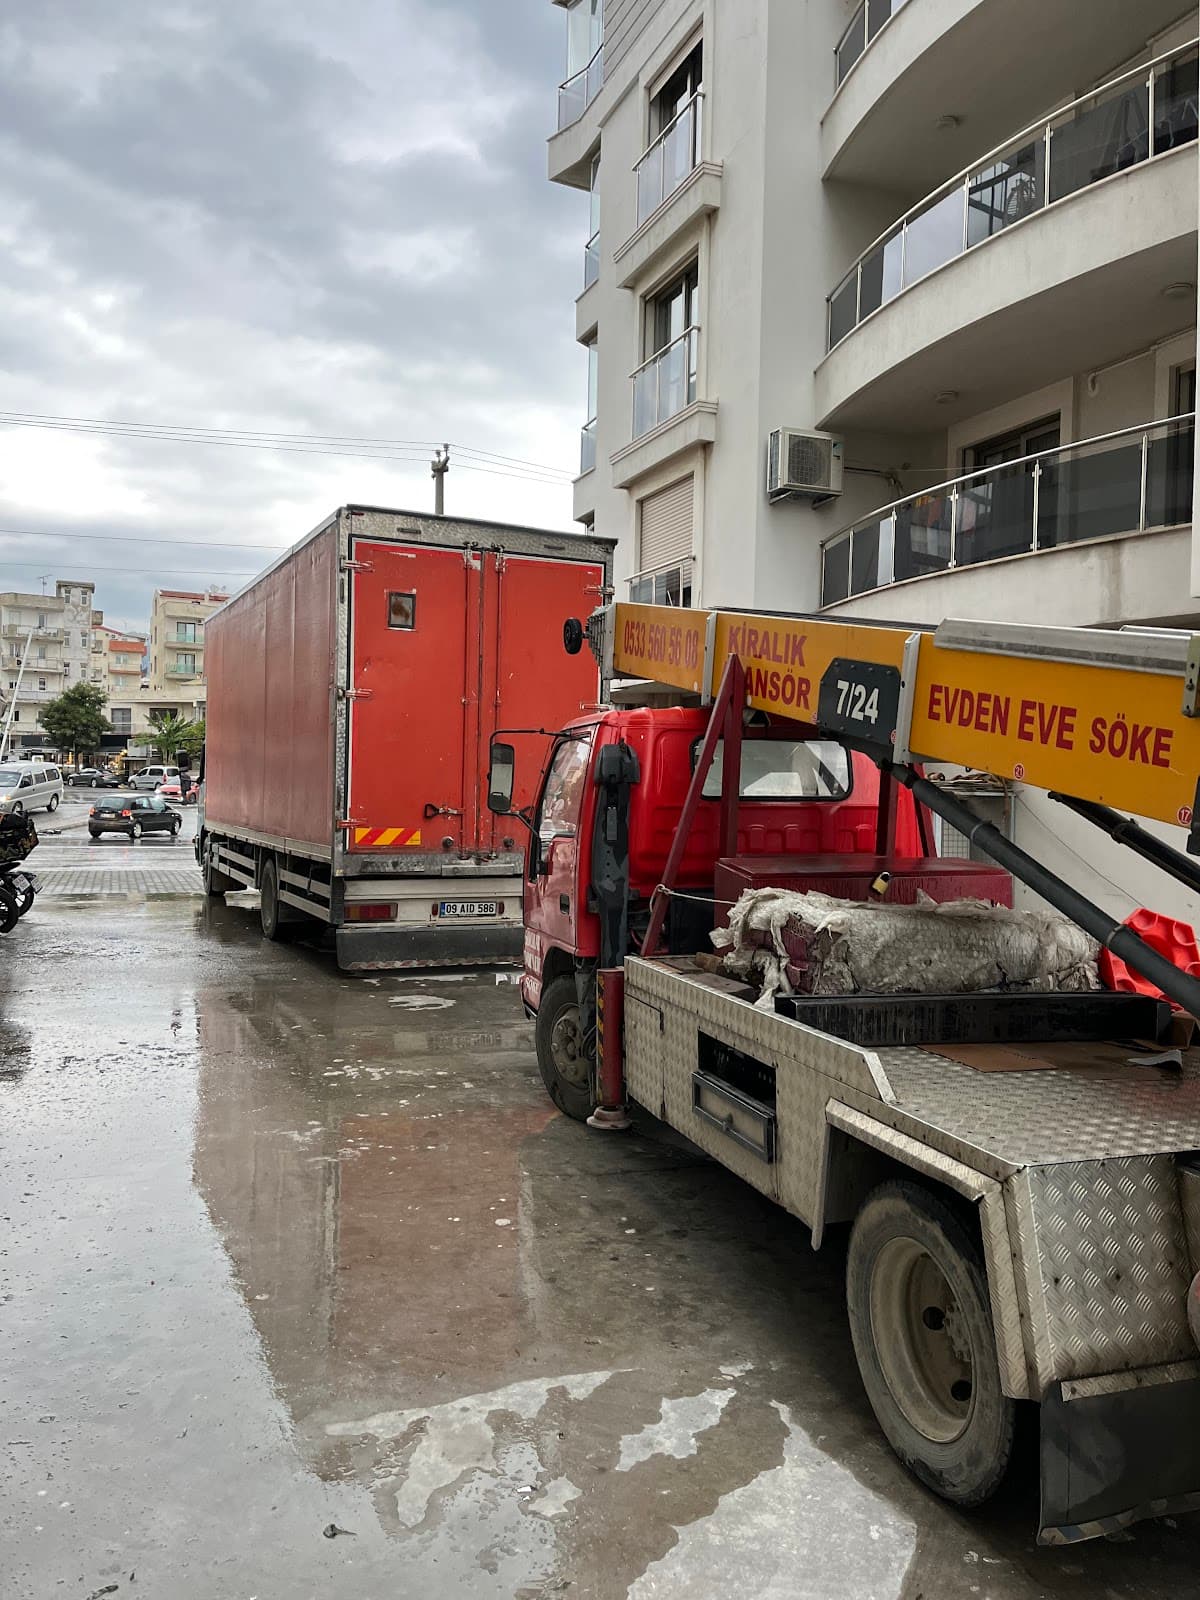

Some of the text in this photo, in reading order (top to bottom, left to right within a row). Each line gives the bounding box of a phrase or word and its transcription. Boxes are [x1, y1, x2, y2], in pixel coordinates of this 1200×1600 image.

[624, 620, 646, 658] 0533
[648, 624, 666, 662] 560
[685, 629, 699, 669] 08
[728, 621, 807, 667] KİRALIK
[836, 679, 879, 725] 7/24
[927, 683, 1174, 768] EVDEN EVE SÖKE
[1179, 808, 1192, 824] 17
[446, 904, 457, 914] 09
[460, 904, 475, 913] AID
[477, 903, 494, 913] 586
